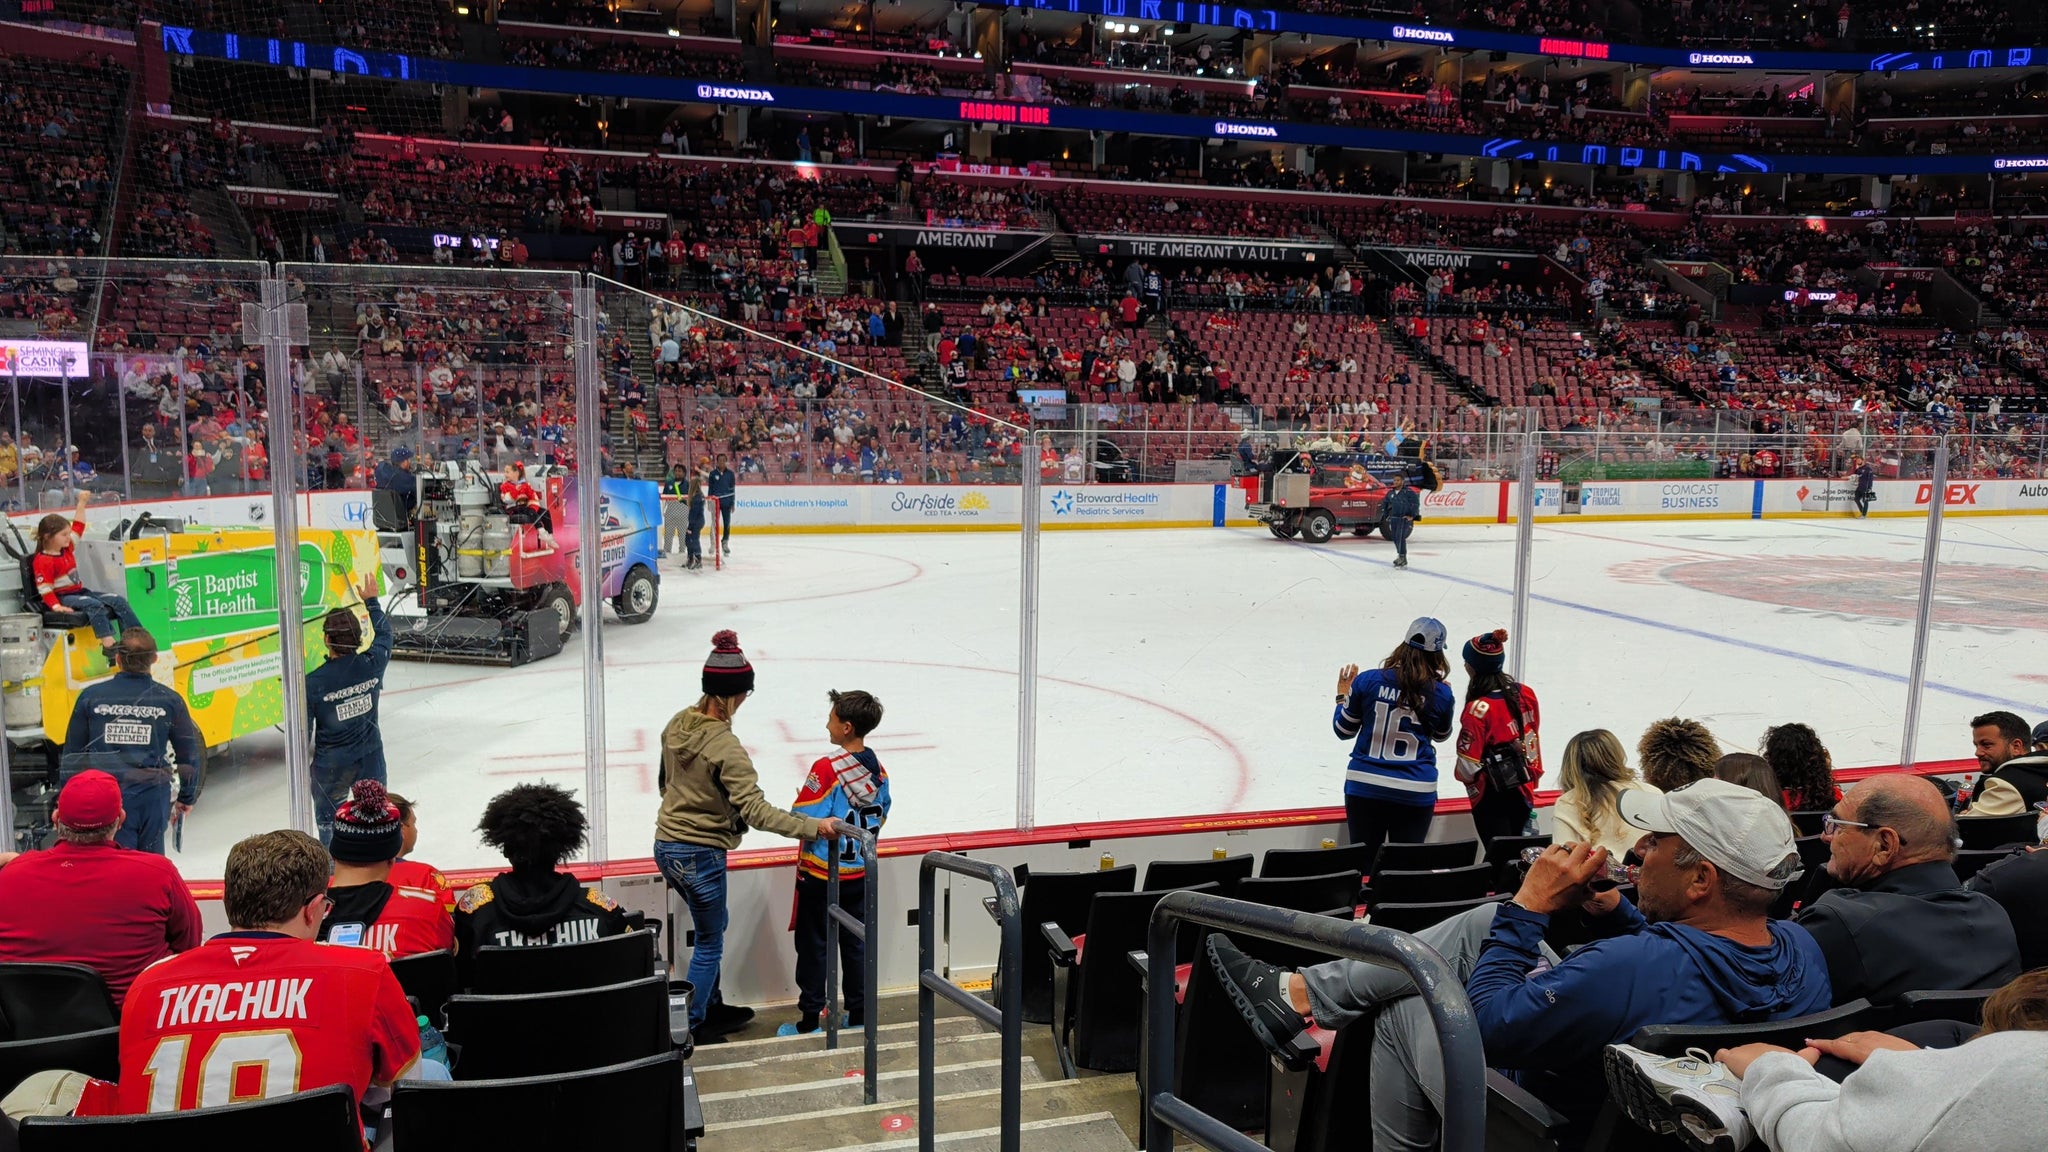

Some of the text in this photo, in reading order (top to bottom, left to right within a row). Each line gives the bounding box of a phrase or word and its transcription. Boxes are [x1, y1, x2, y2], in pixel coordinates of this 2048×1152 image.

[1405, 29, 1454, 41] HONDA
[1585, 43, 1608, 59] RIDE
[1702, 55, 1753, 63] HONDA
[713, 87, 774, 101] HONDA
[1020, 106, 1049, 124] RIDE
[1228, 124, 1278, 136] HONDA
[916, 231, 997, 248] AMERANT
[1130, 241, 1288, 260] THE AMERANT VAULT
[1406, 252, 1472, 268] AMERANT
[1592, 488, 1620, 496] TROPICAL
[1663, 484, 1719, 495] COMCAST
[737, 499, 848, 508] Nicklaus Children's Hospital
[891, 492, 955, 511] Surfside
[1076, 493, 1159, 503] Broward Health
[1662, 497, 1718, 508] BUSINESS
[1076, 507, 1144, 516] Pediatric Services
[205, 569, 258, 596] Baptist
[206, 592, 256, 615] Health
[212, 666, 232, 677] Official
[233, 663, 250, 672] Sports
[1469, 699, 1490, 719] 19
[107, 725, 150, 735] STANLEY
[1368, 701, 1422, 761] 16
[106, 734, 149, 743] STEEMER
[157, 978, 313, 1029] TKACHUK
[891, 1118, 902, 1128] 3
